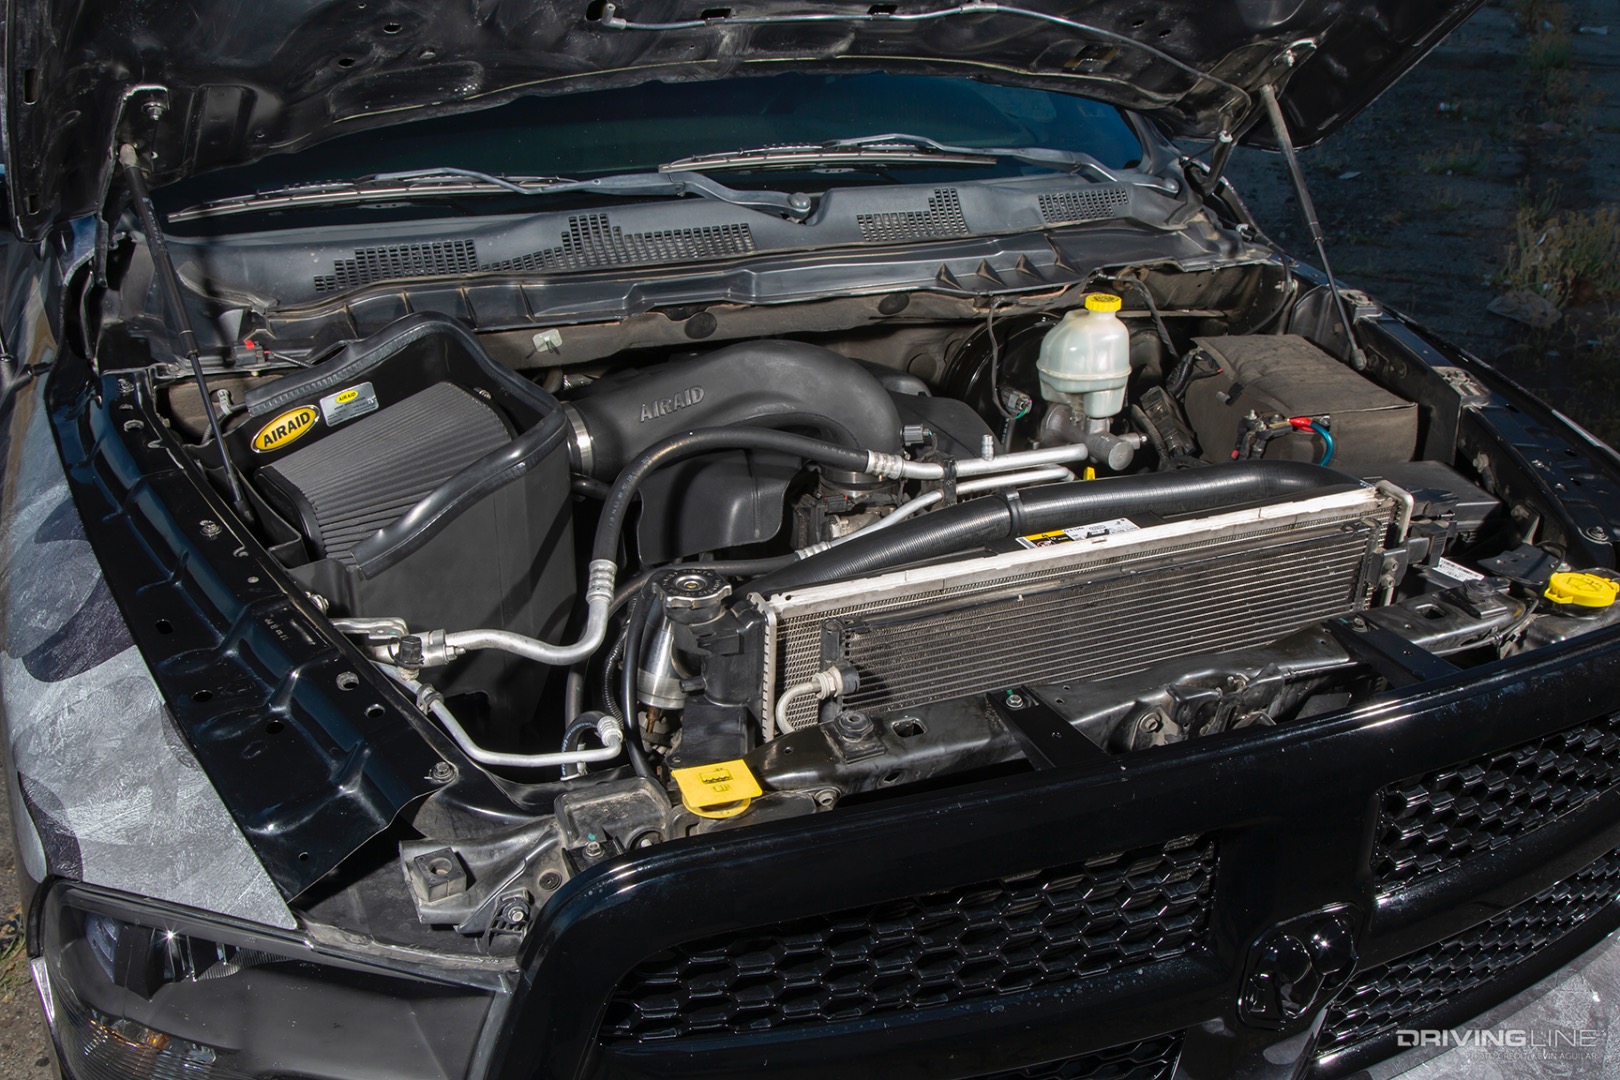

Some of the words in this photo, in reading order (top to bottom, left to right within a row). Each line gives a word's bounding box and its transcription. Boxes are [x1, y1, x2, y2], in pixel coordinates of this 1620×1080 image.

[338, 391, 356, 402] AIRAID
[640, 385, 705, 423] AIRAID
[263, 411, 311, 448] AIRAID
